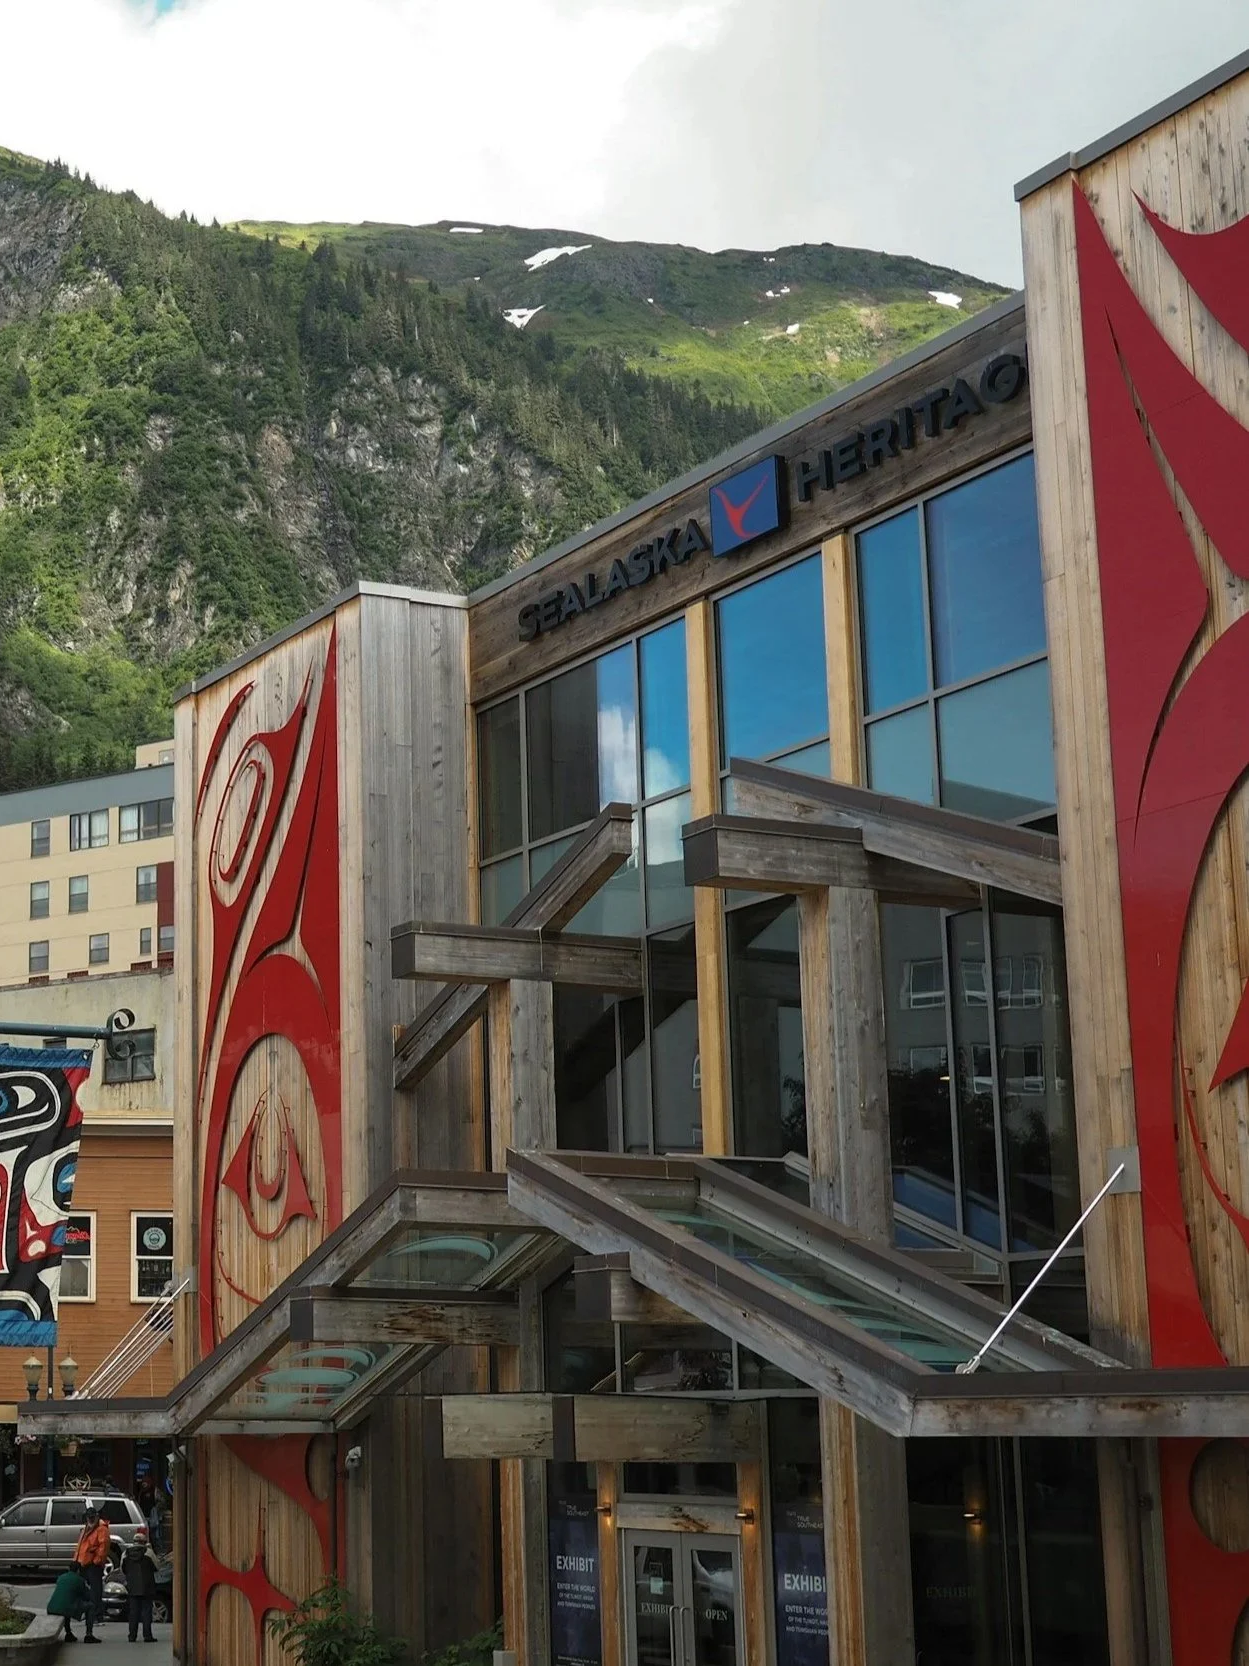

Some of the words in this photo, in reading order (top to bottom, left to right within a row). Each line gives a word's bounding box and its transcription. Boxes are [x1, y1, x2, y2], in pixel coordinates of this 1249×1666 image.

[518, 518, 710, 642] SEALASKA
[796, 353, 1026, 502] HERITAG
[556, 1555, 594, 1573] EXHIBIT
[784, 1573, 826, 1593] EXHIBI
[641, 1602, 671, 1615] EXHIBI
[705, 1609, 728, 1621] OPEN
